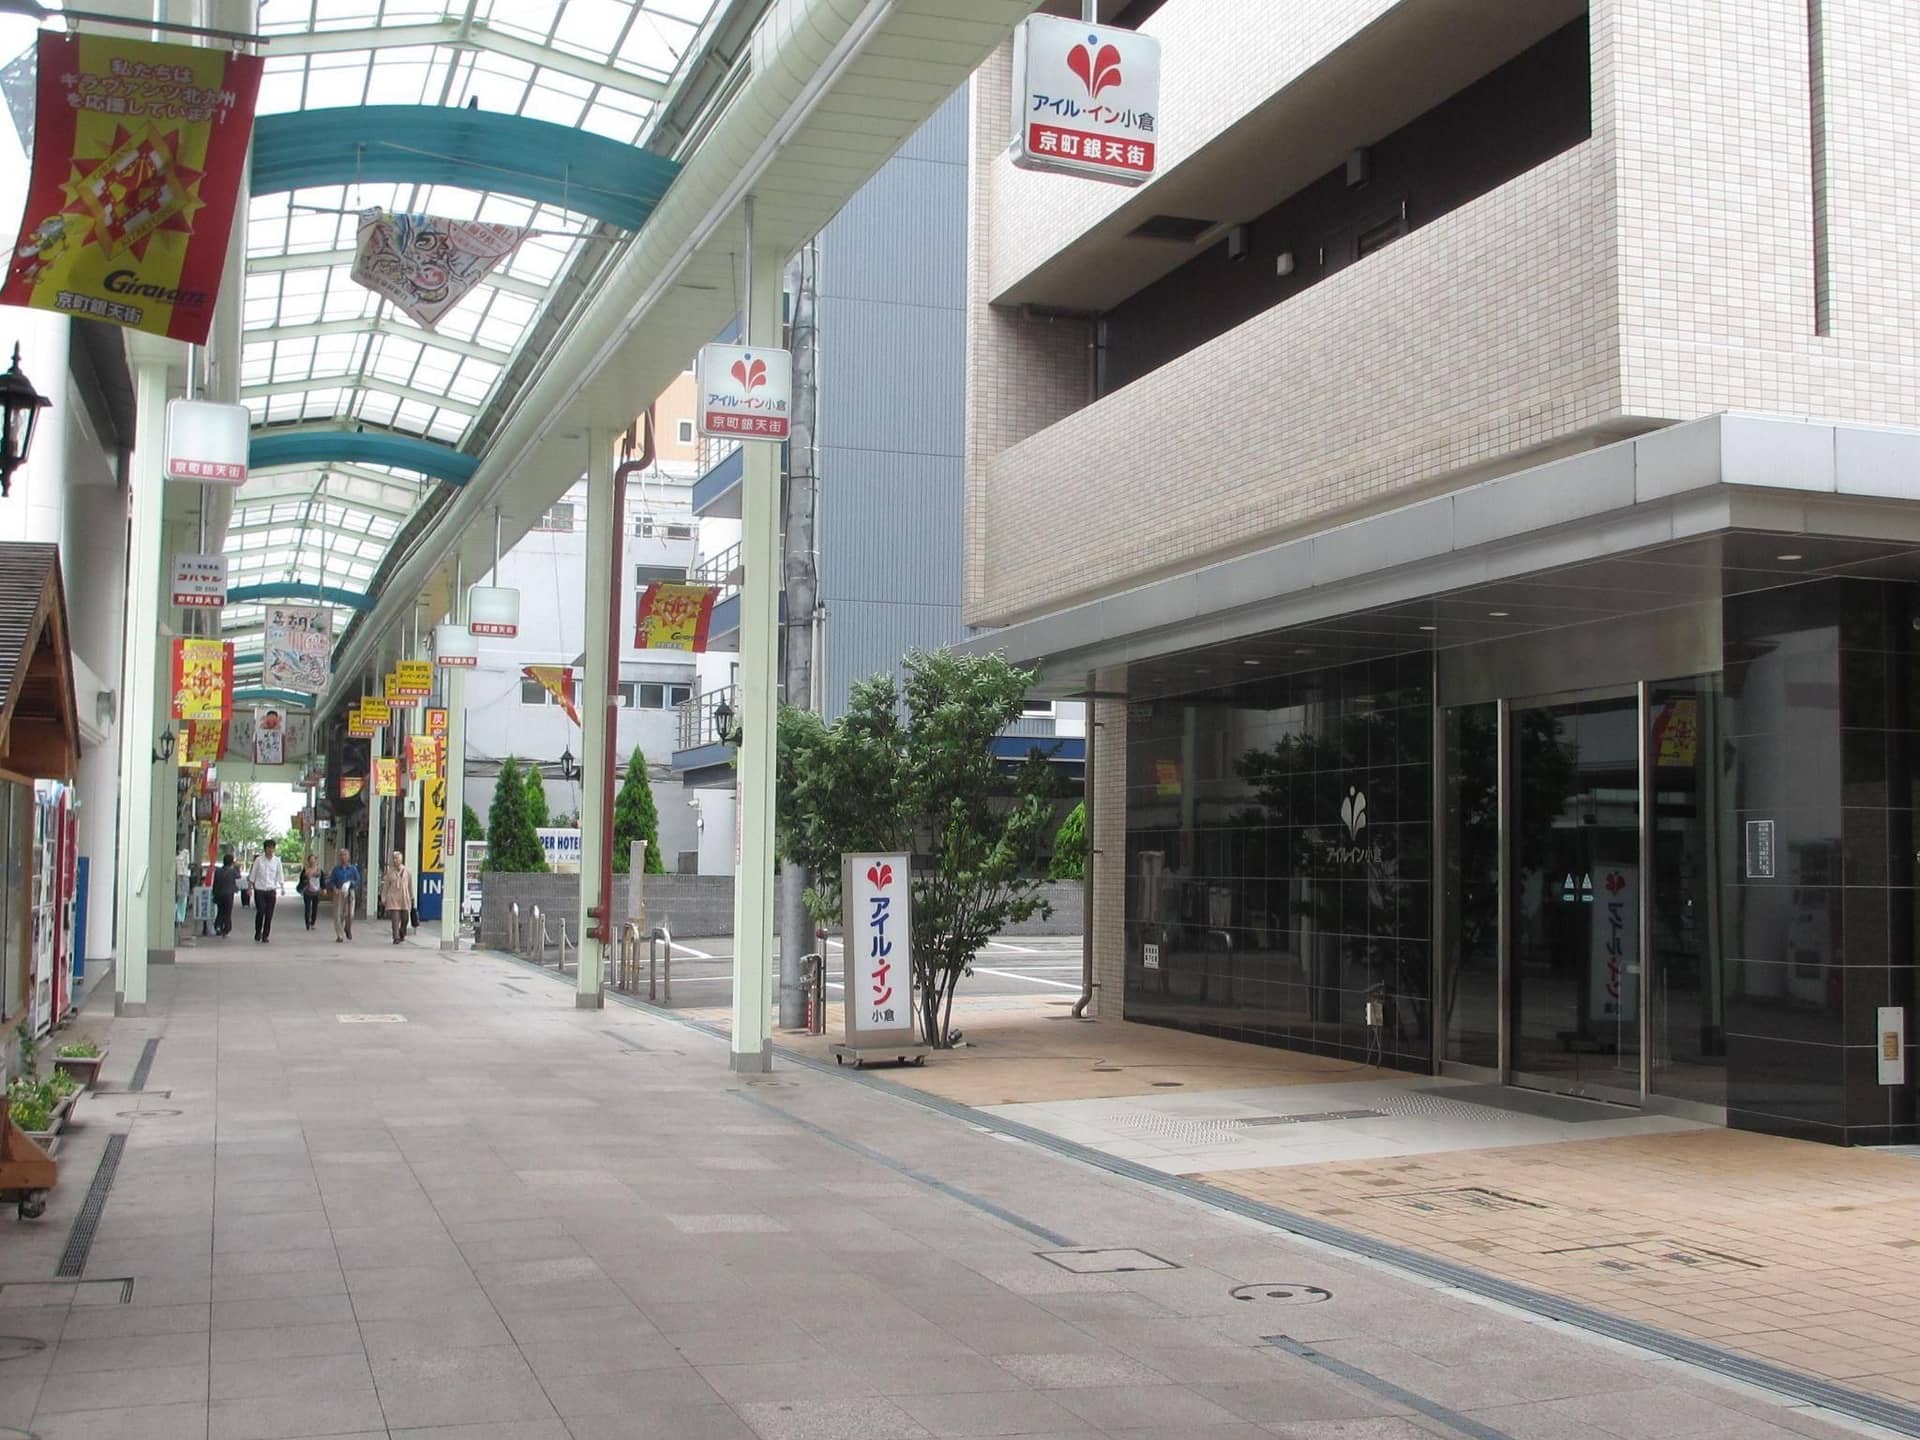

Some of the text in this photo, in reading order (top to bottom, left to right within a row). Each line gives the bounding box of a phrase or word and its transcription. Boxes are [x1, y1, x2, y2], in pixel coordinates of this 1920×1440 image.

[1032, 94, 1155, 132] アイル・イン小倉
[1038, 130, 1145, 166] 京町銀天街
[708, 393, 786, 412] アイル・イン小倉
[713, 415, 783, 433] 京町銀天街
[869, 897, 893, 1006] アイル・イン
[871, 1008, 895, 1023] 小倉
